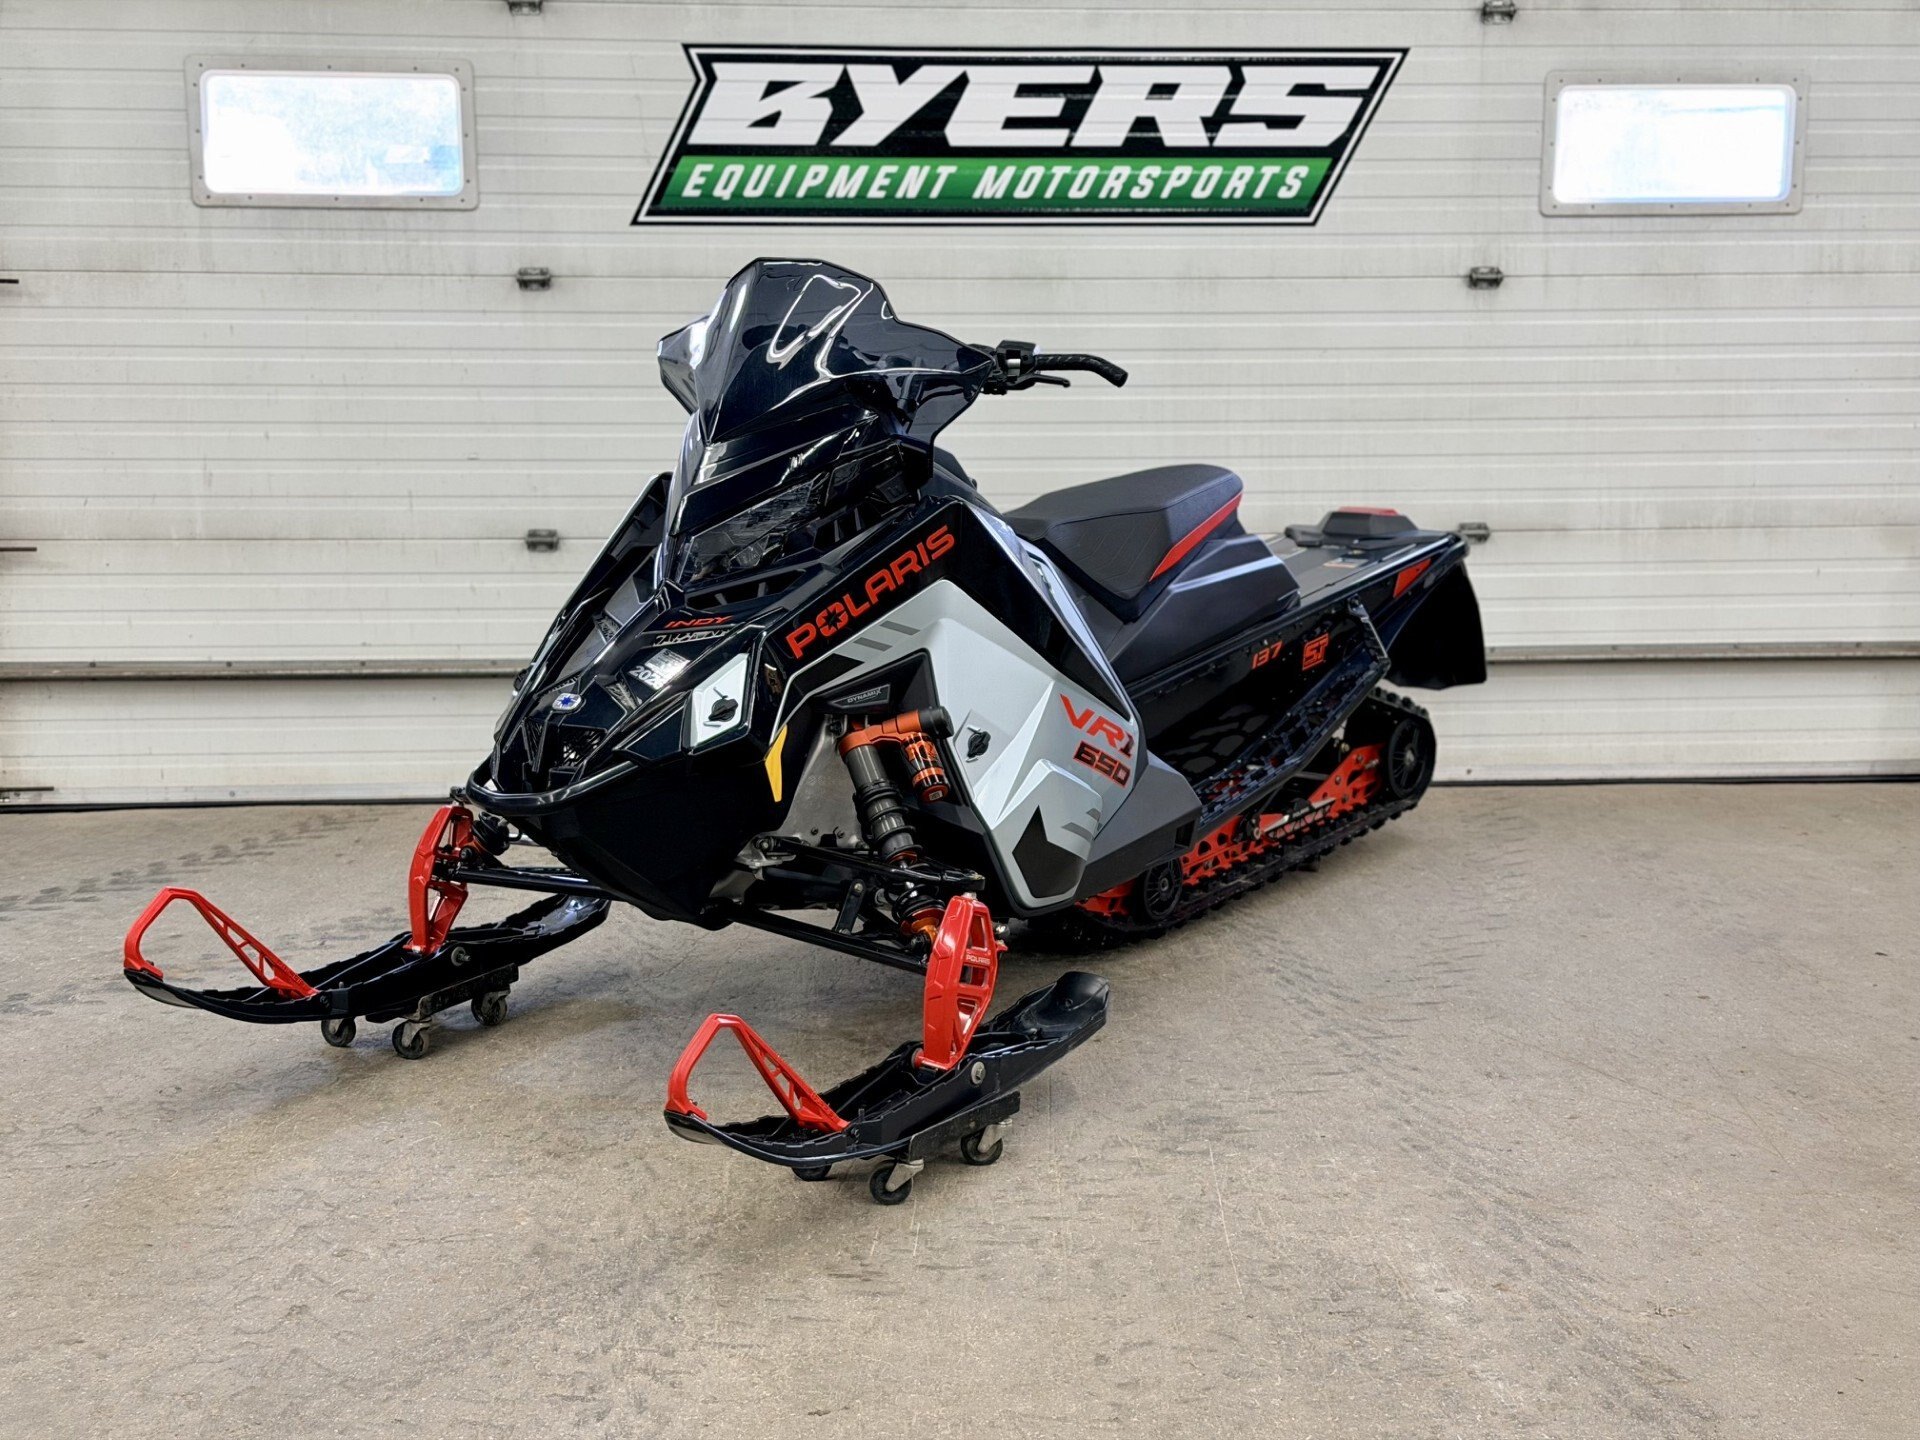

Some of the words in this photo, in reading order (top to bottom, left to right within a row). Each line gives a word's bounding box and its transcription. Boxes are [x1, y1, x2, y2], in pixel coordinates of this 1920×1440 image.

[687, 62, 1380, 147] BYERS
[681, 163, 957, 200] EQUIPMENT
[972, 165, 1310, 200] MOTORSPORTS
[785, 524, 956, 660] POLARIS
[663, 615, 733, 629] INDY
[1252, 640, 1283, 669] 137
[1060, 693, 1135, 758] VR1
[1073, 740, 1132, 787] 650
